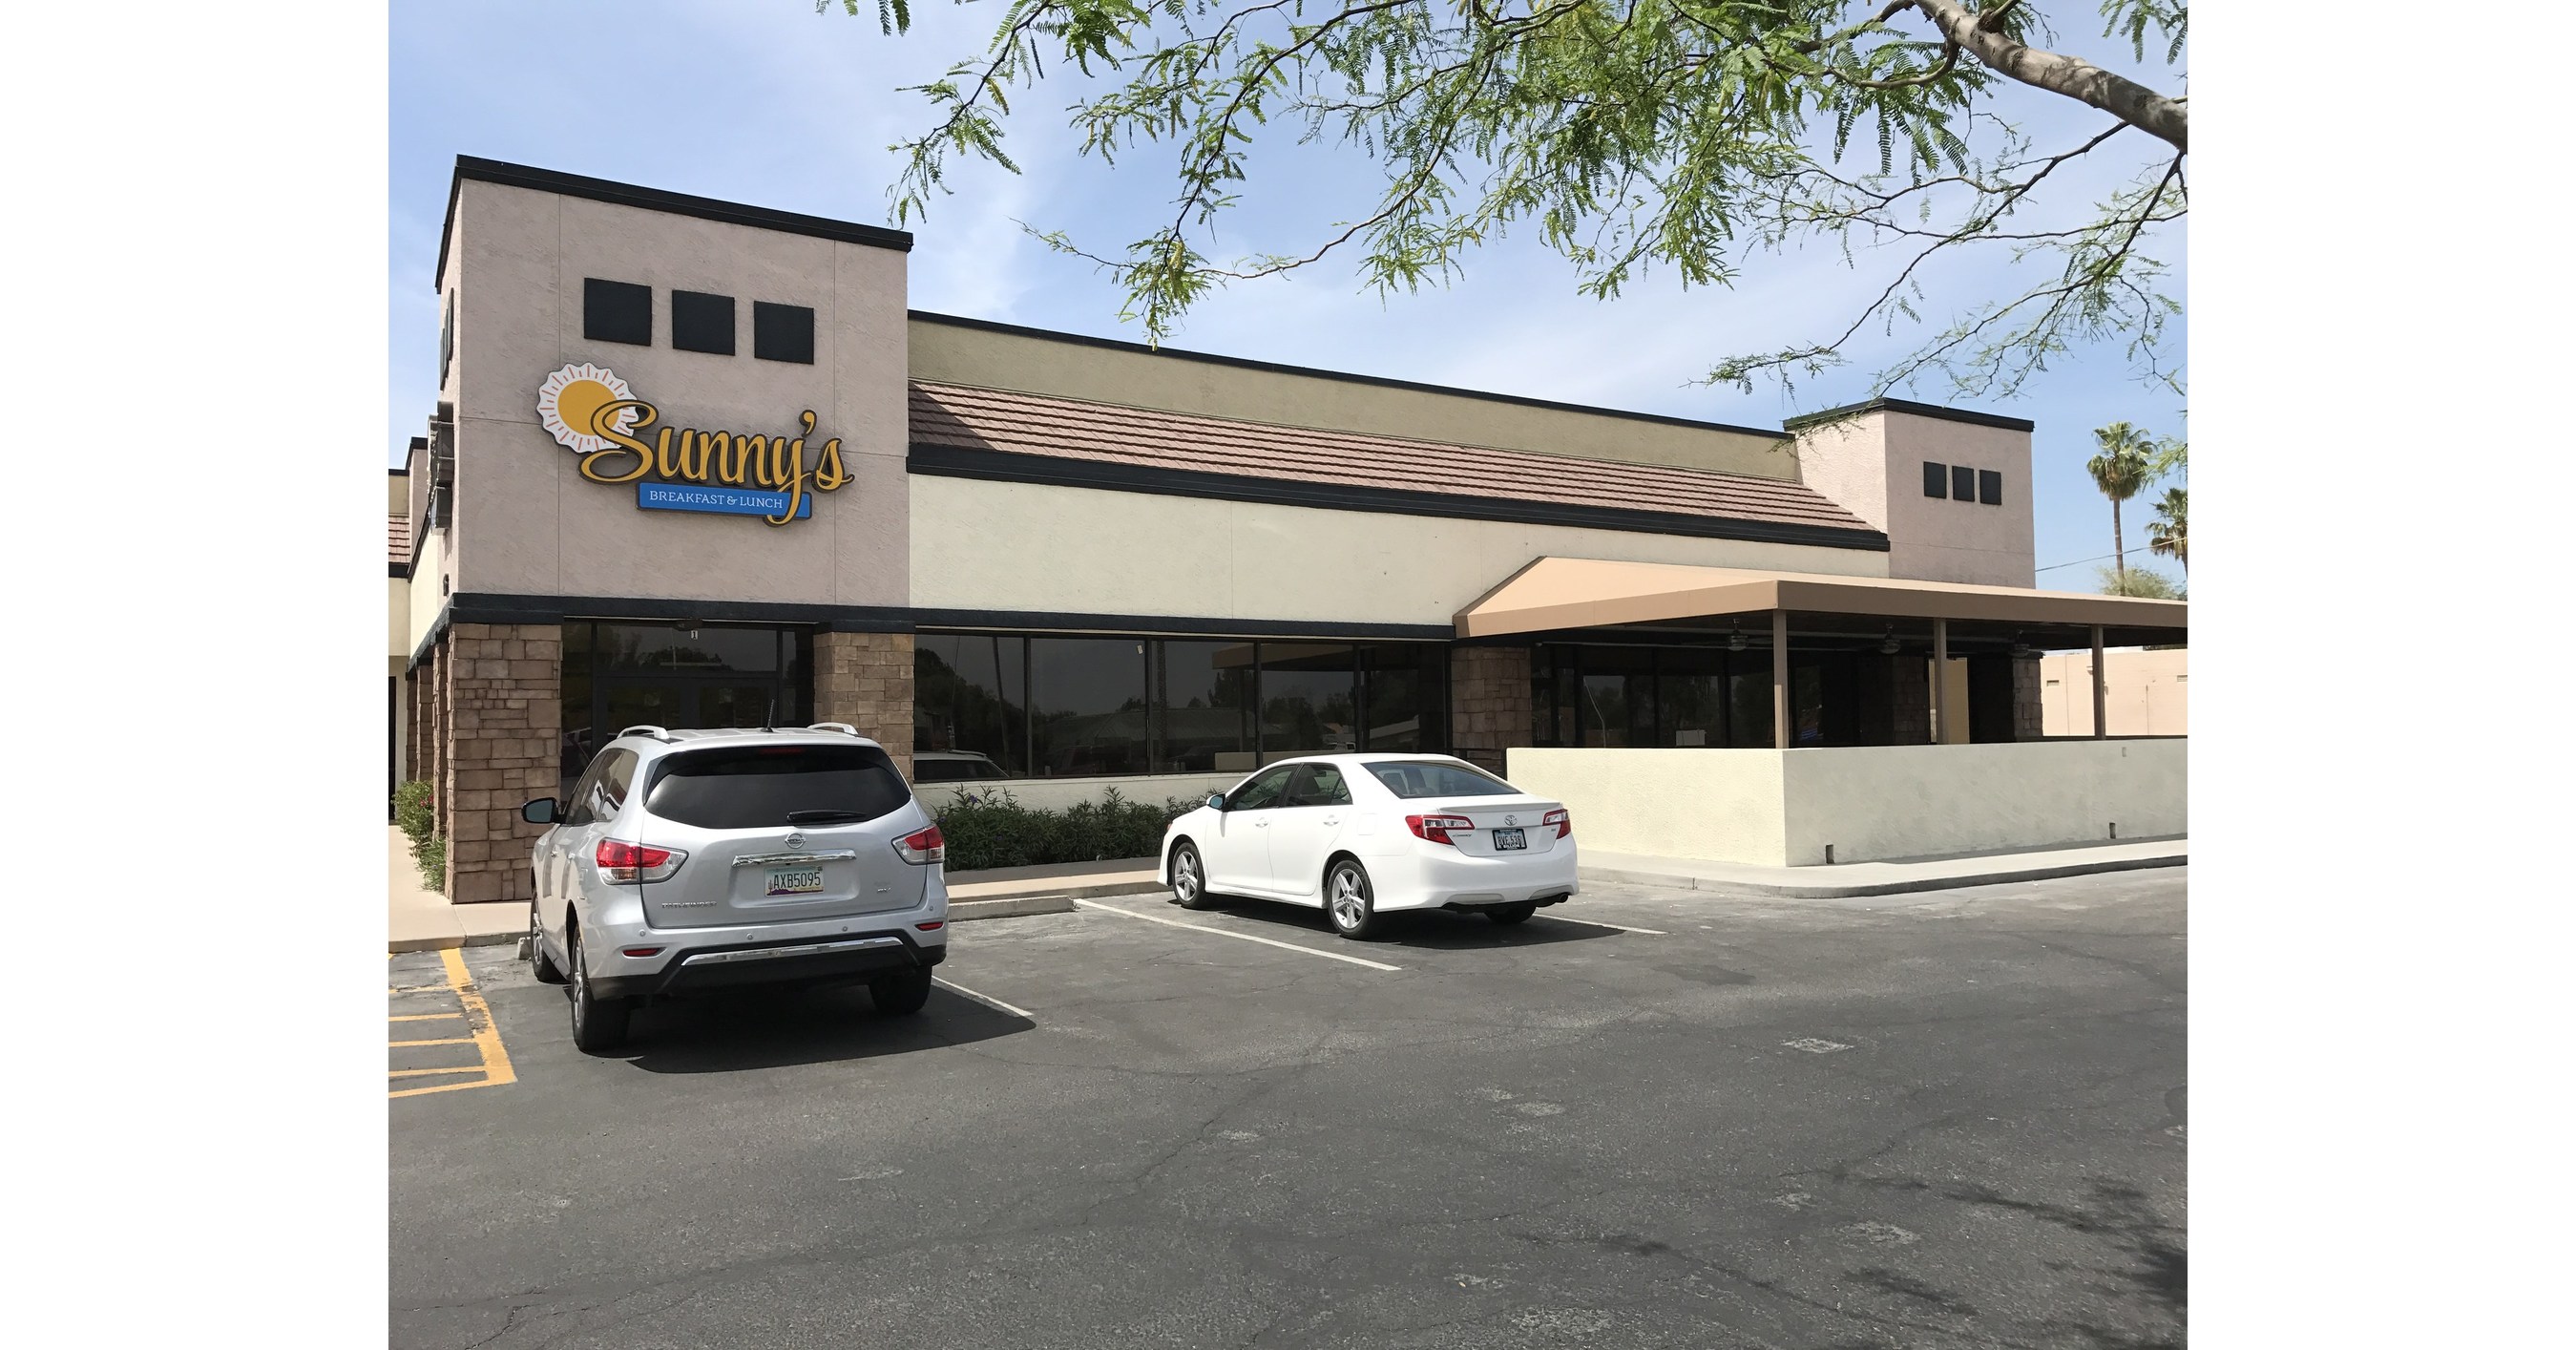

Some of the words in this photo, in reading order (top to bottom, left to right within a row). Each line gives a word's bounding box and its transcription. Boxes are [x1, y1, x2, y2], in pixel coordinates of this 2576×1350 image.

[578, 399, 855, 526] Sunny's
[649, 490, 725, 506] BREAKFAST
[726, 495, 738, 506] &
[739, 496, 784, 509] LUNCH
[773, 872, 822, 889] AXB5095
